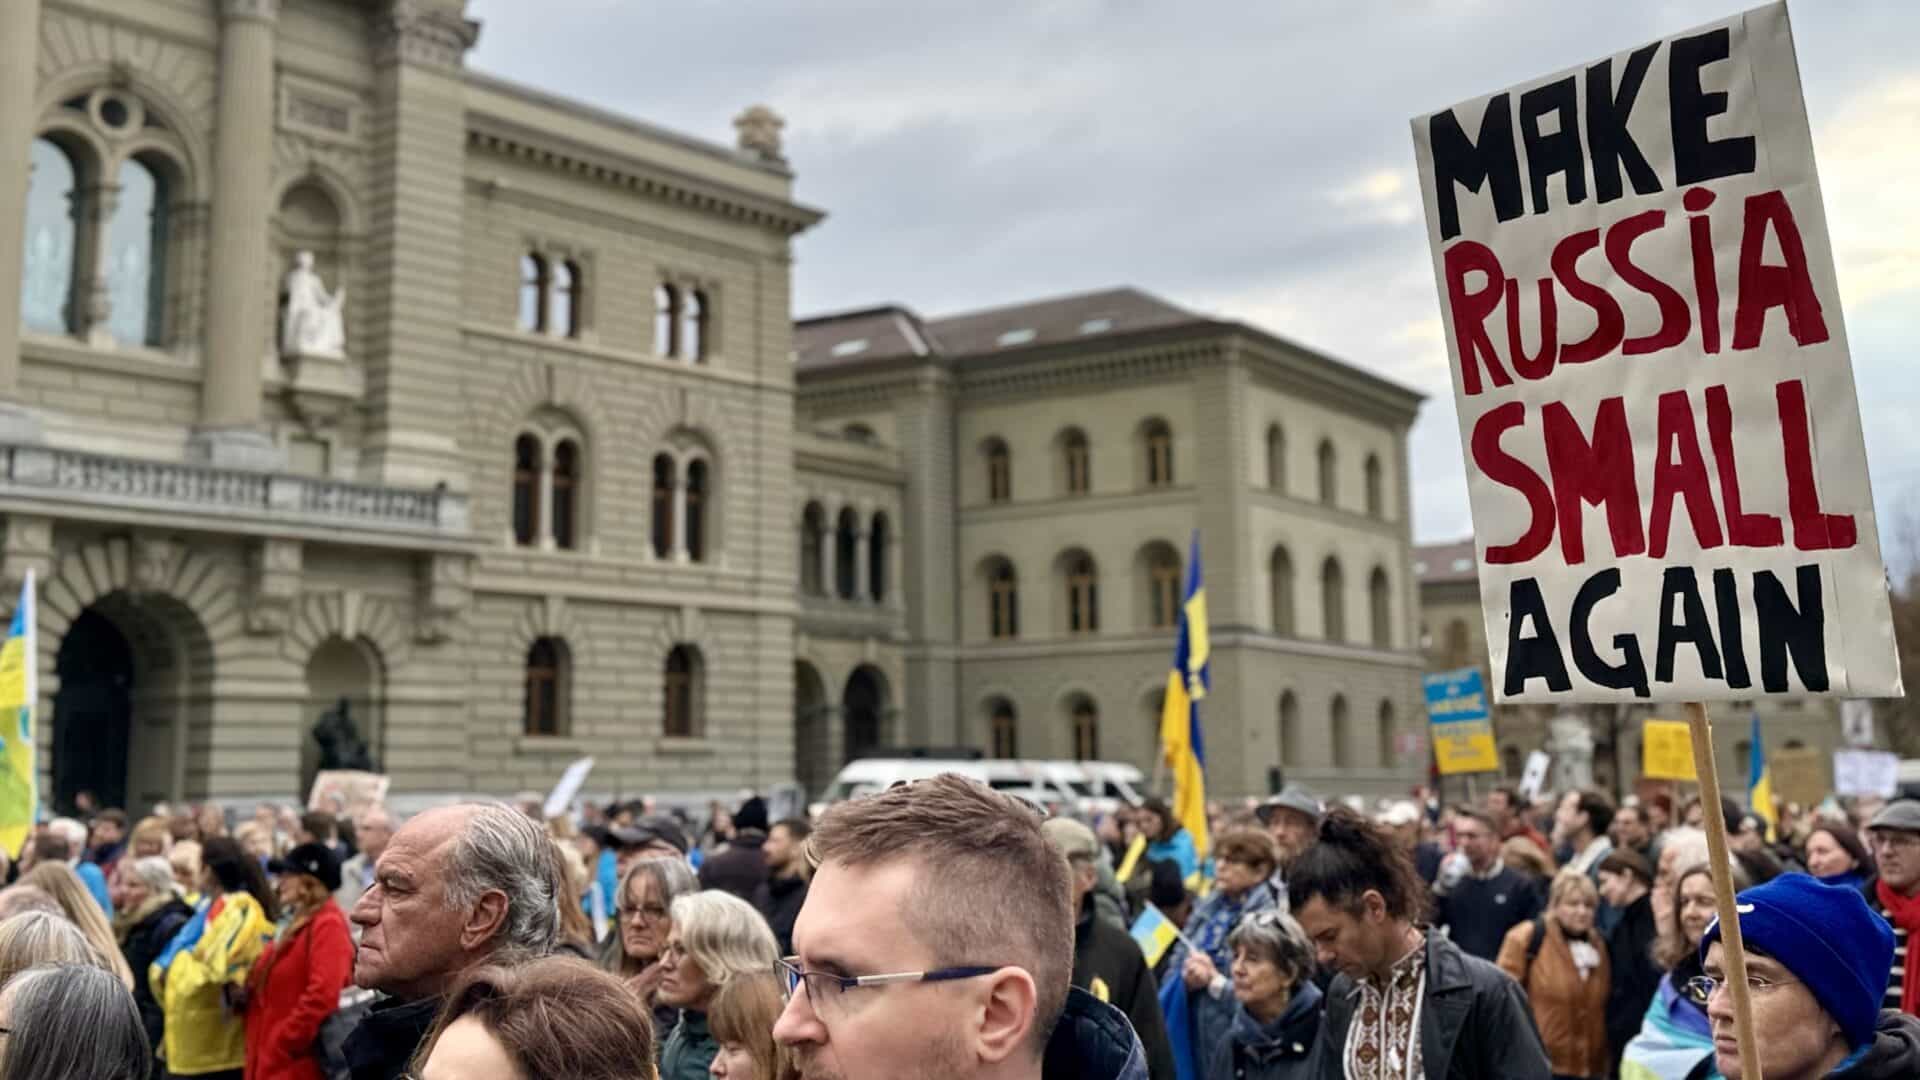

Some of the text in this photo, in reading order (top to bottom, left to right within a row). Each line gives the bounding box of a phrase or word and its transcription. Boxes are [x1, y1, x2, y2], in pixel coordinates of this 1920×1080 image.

[1429, 28, 1757, 241] MAKE
[1471, 379, 1857, 566] SMALL
[1503, 564, 1830, 697] AGAIN
